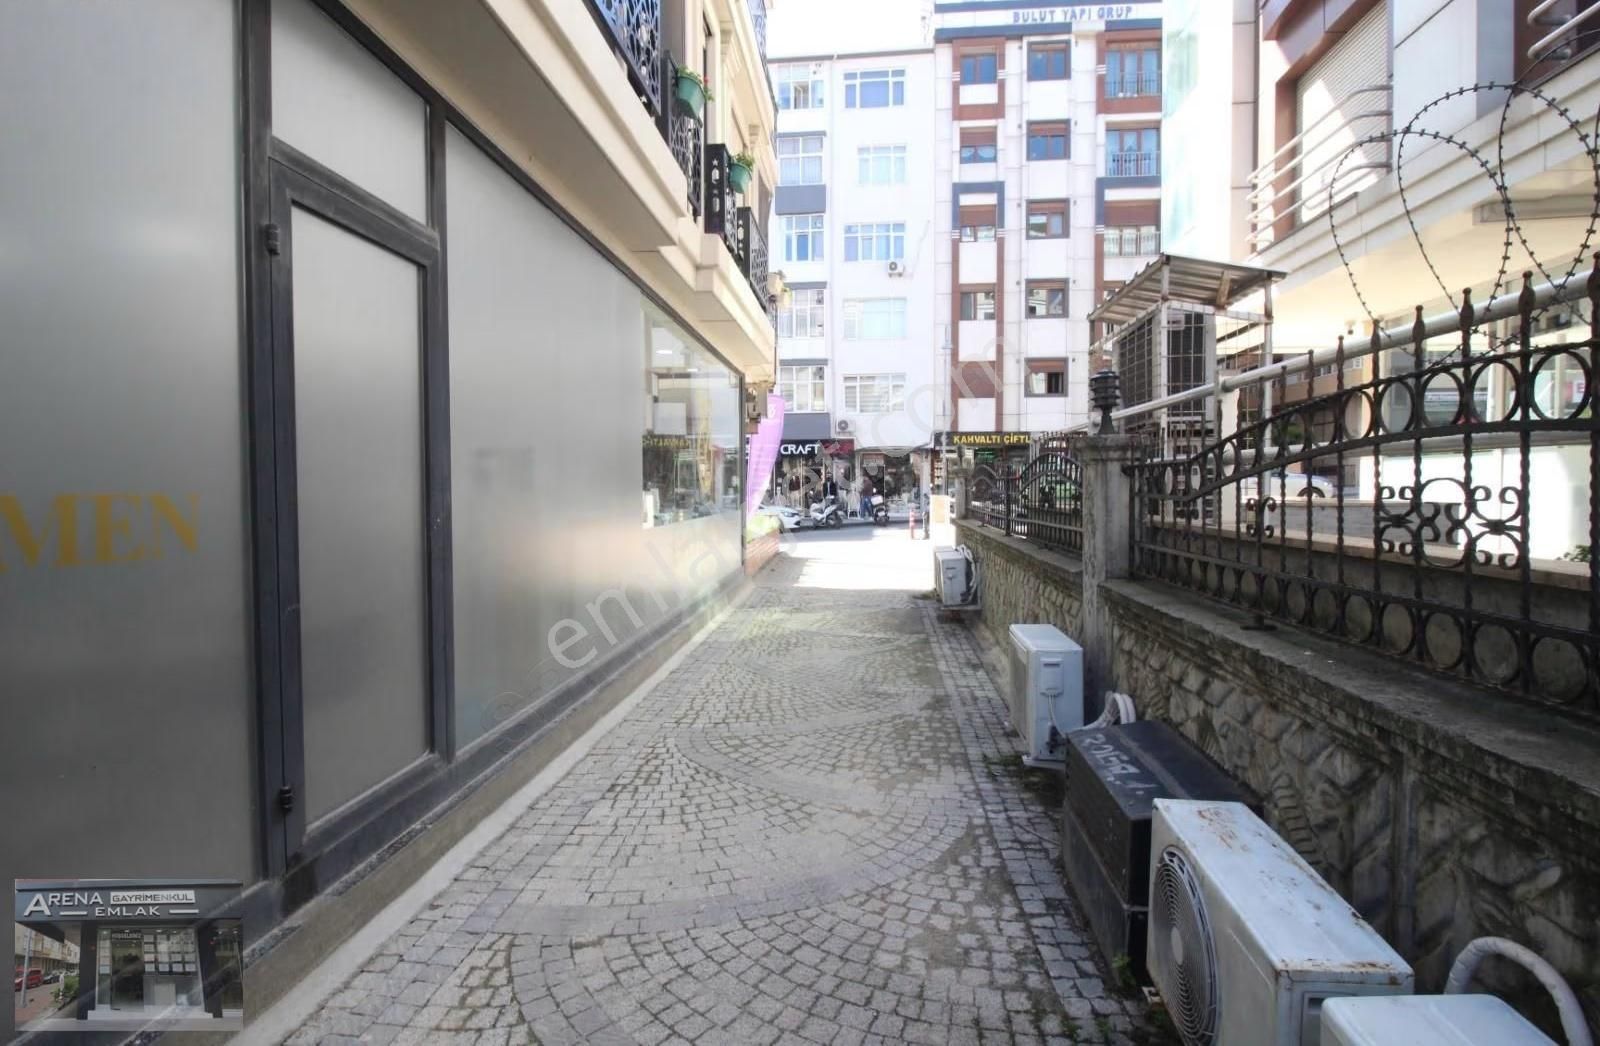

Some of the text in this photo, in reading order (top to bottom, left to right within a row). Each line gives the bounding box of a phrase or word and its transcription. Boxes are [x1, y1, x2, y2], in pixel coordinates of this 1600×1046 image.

[1013, 6, 1133, 23] BULUT YAPI GRUP
[953, 432, 1031, 445] KAHVALTI ÇİFTL
[780, 444, 820, 454] CRAFT
